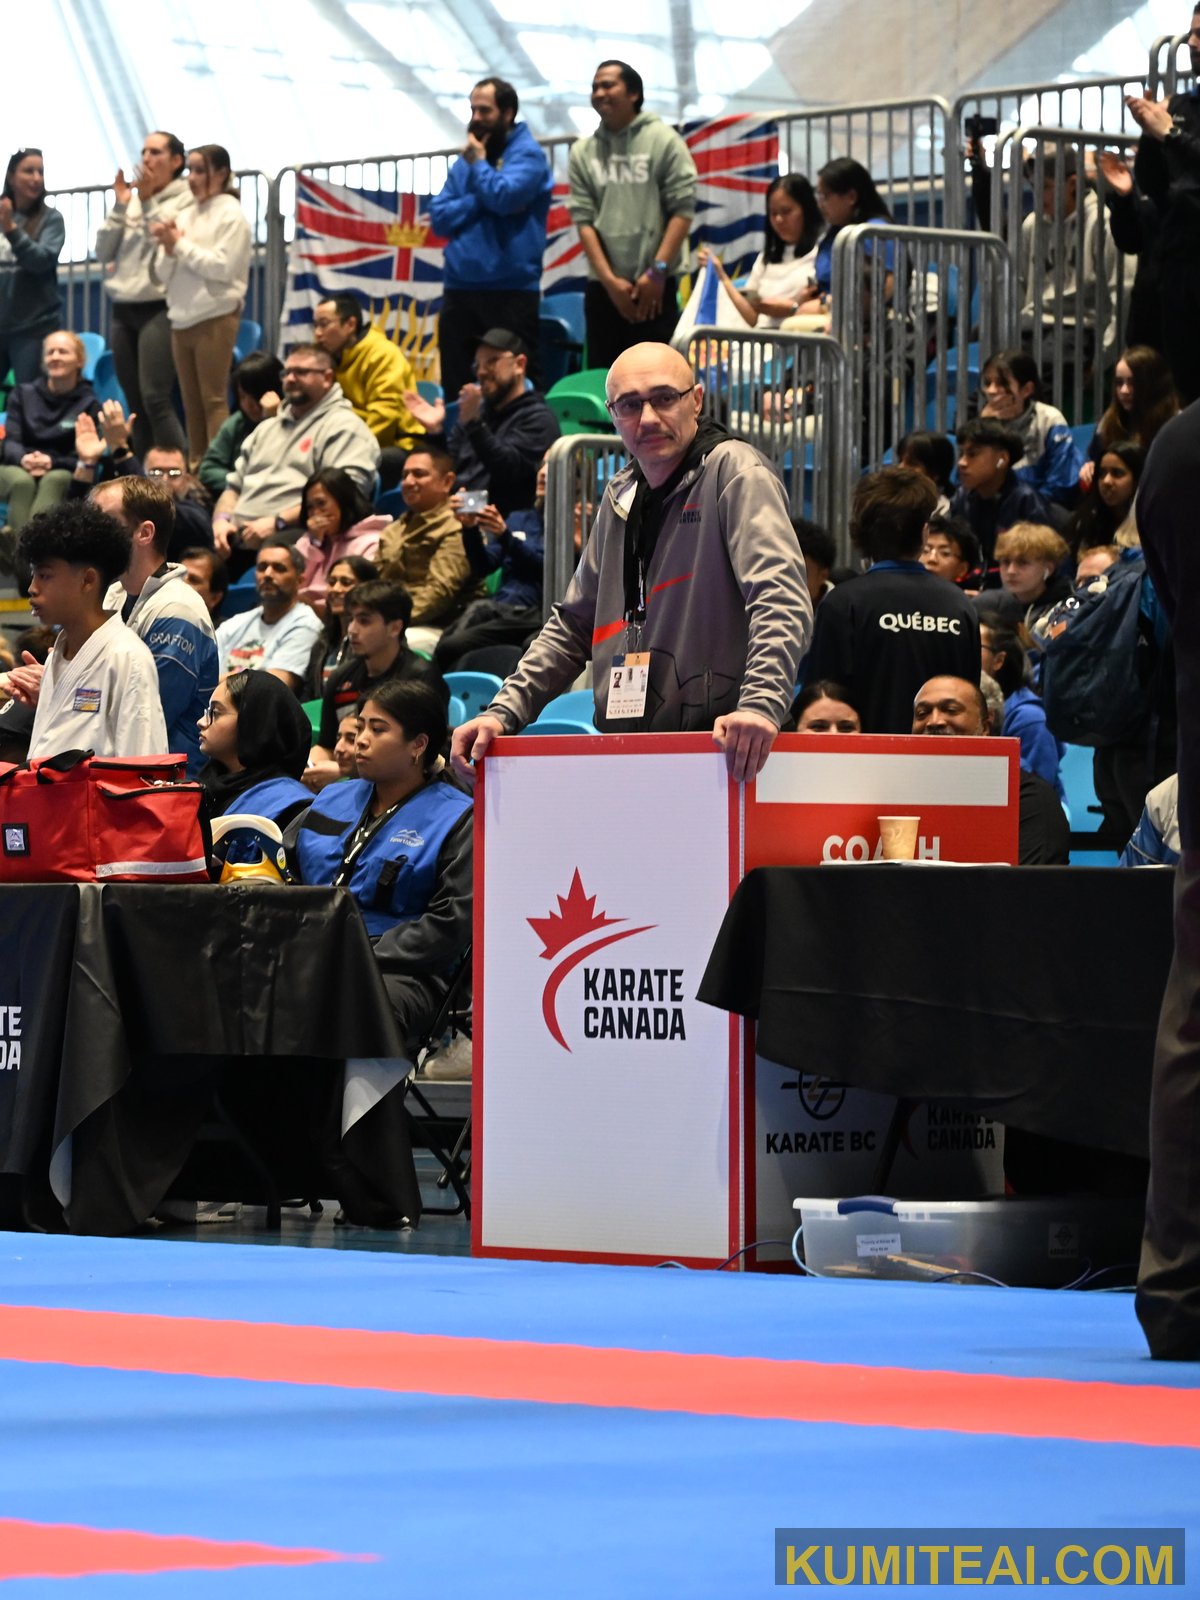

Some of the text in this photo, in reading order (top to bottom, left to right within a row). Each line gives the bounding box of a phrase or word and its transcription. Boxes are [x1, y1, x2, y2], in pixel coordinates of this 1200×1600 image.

[879, 611, 961, 636] QUÉBEC
[822, 835, 940, 861] COH
[583, 967, 684, 1002] KARATE
[584, 1006, 686, 1040] CANADA
[766, 1130, 876, 1154] KARATE BC
[927, 1127, 996, 1151] CANADA
